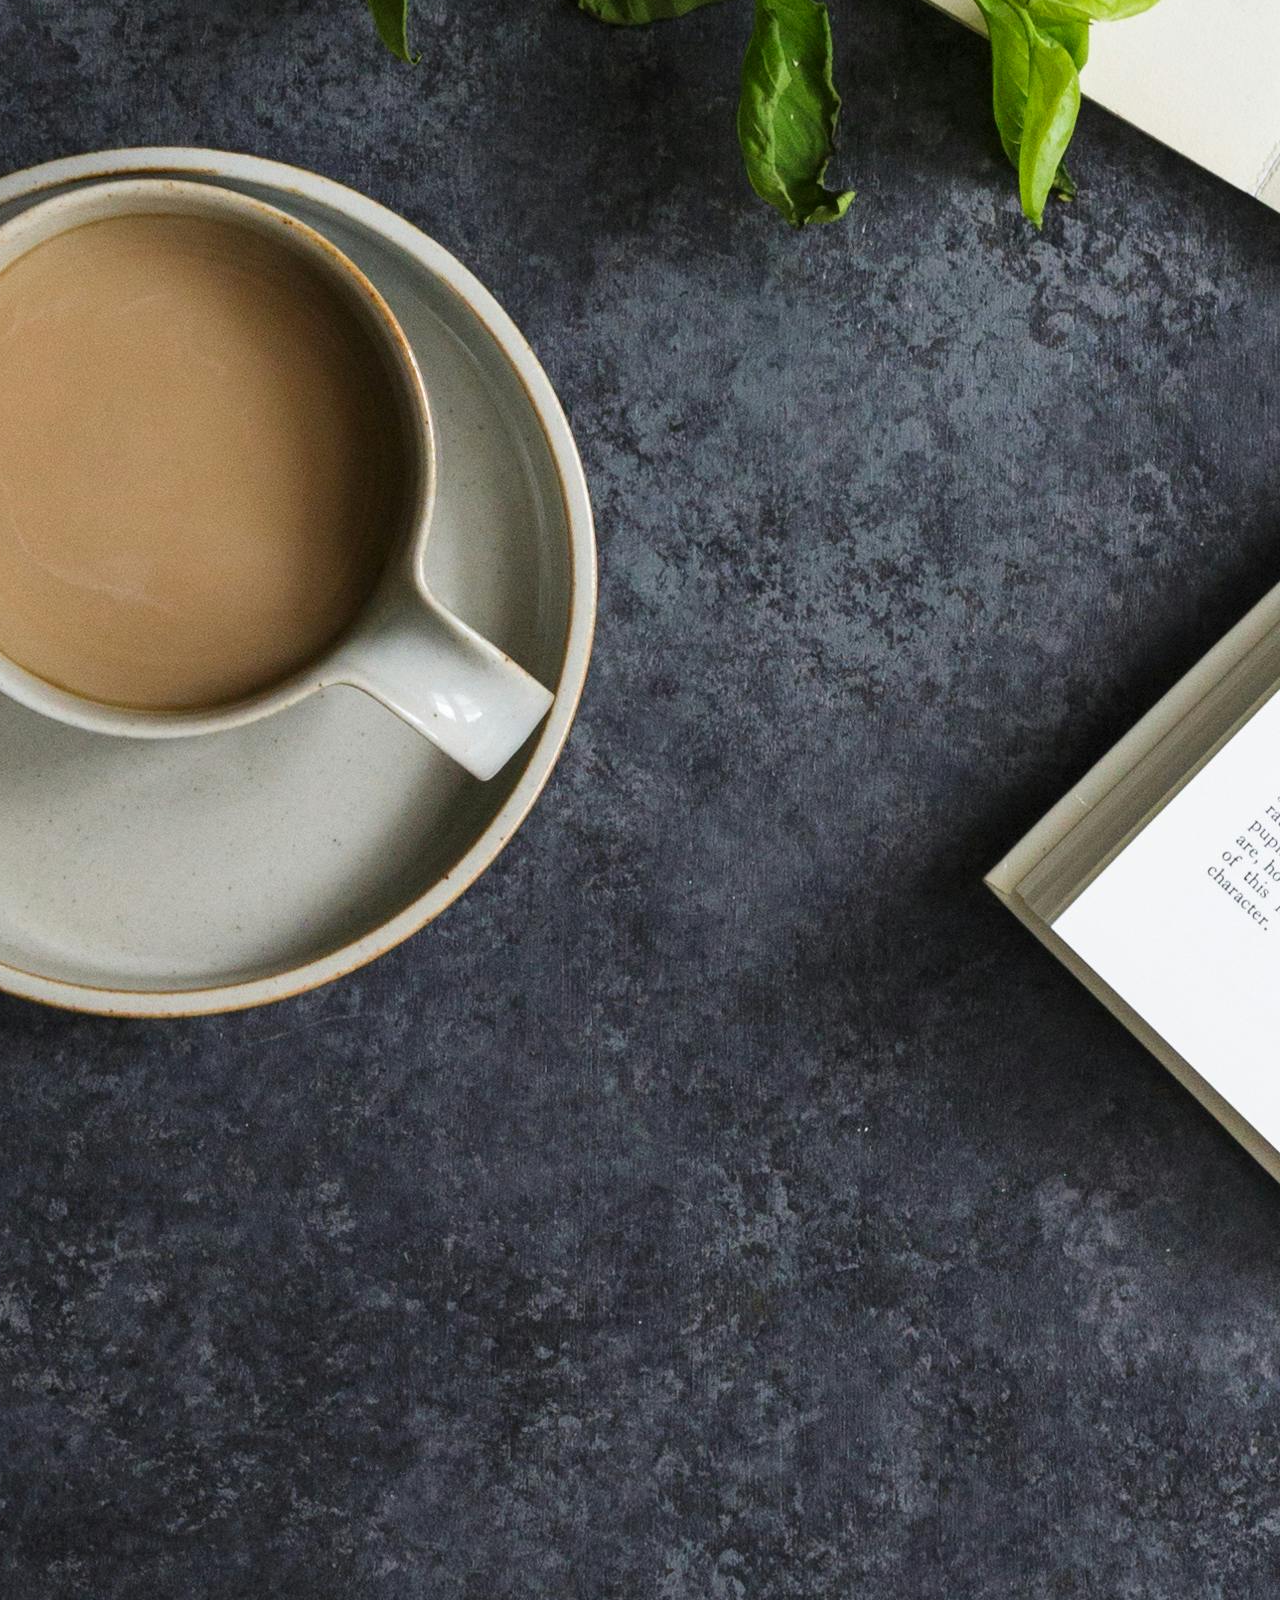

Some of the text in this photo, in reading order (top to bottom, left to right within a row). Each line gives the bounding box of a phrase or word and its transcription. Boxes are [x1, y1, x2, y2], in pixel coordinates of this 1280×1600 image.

[1206, 865, 1269, 932] character.
[1220, 850, 1244, 868] of
[1242, 870, 1270, 899] this
